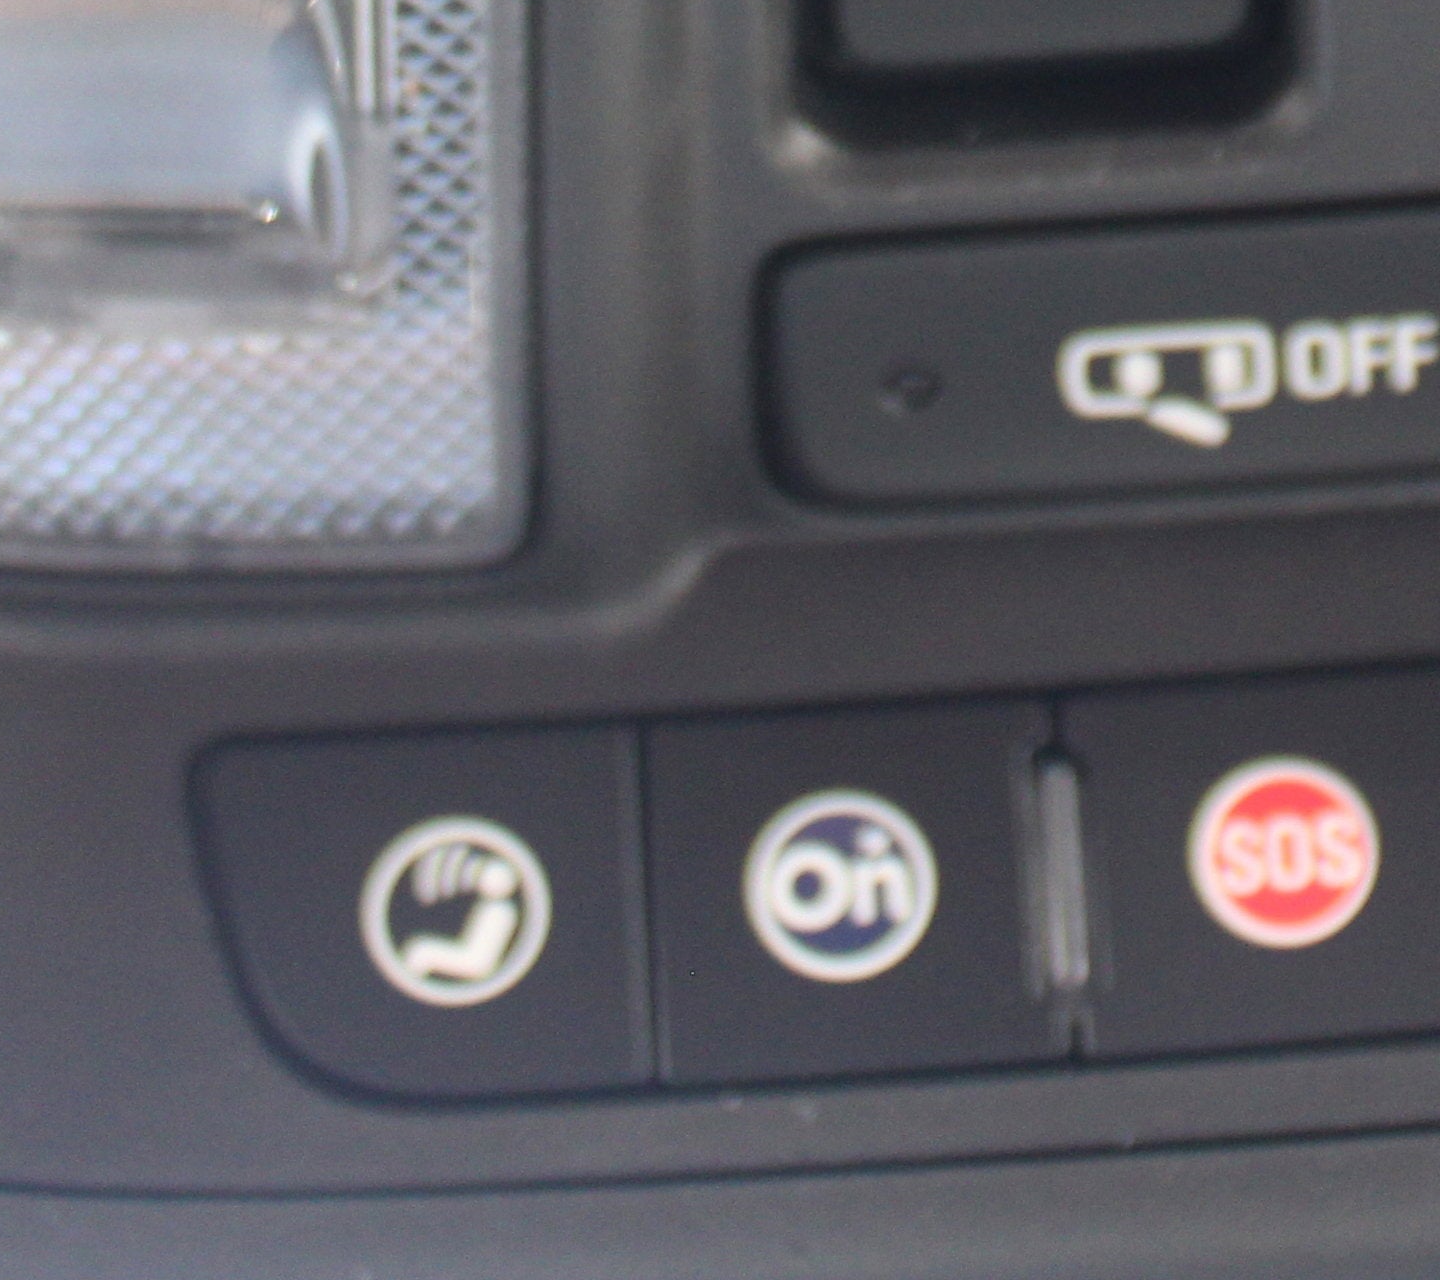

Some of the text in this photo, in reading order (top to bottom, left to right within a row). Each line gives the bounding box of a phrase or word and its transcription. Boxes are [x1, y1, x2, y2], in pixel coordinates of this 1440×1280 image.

[1285, 315, 1440, 401] OFF
[771, 829, 912, 934] On
[1217, 813, 1363, 894] SOS
